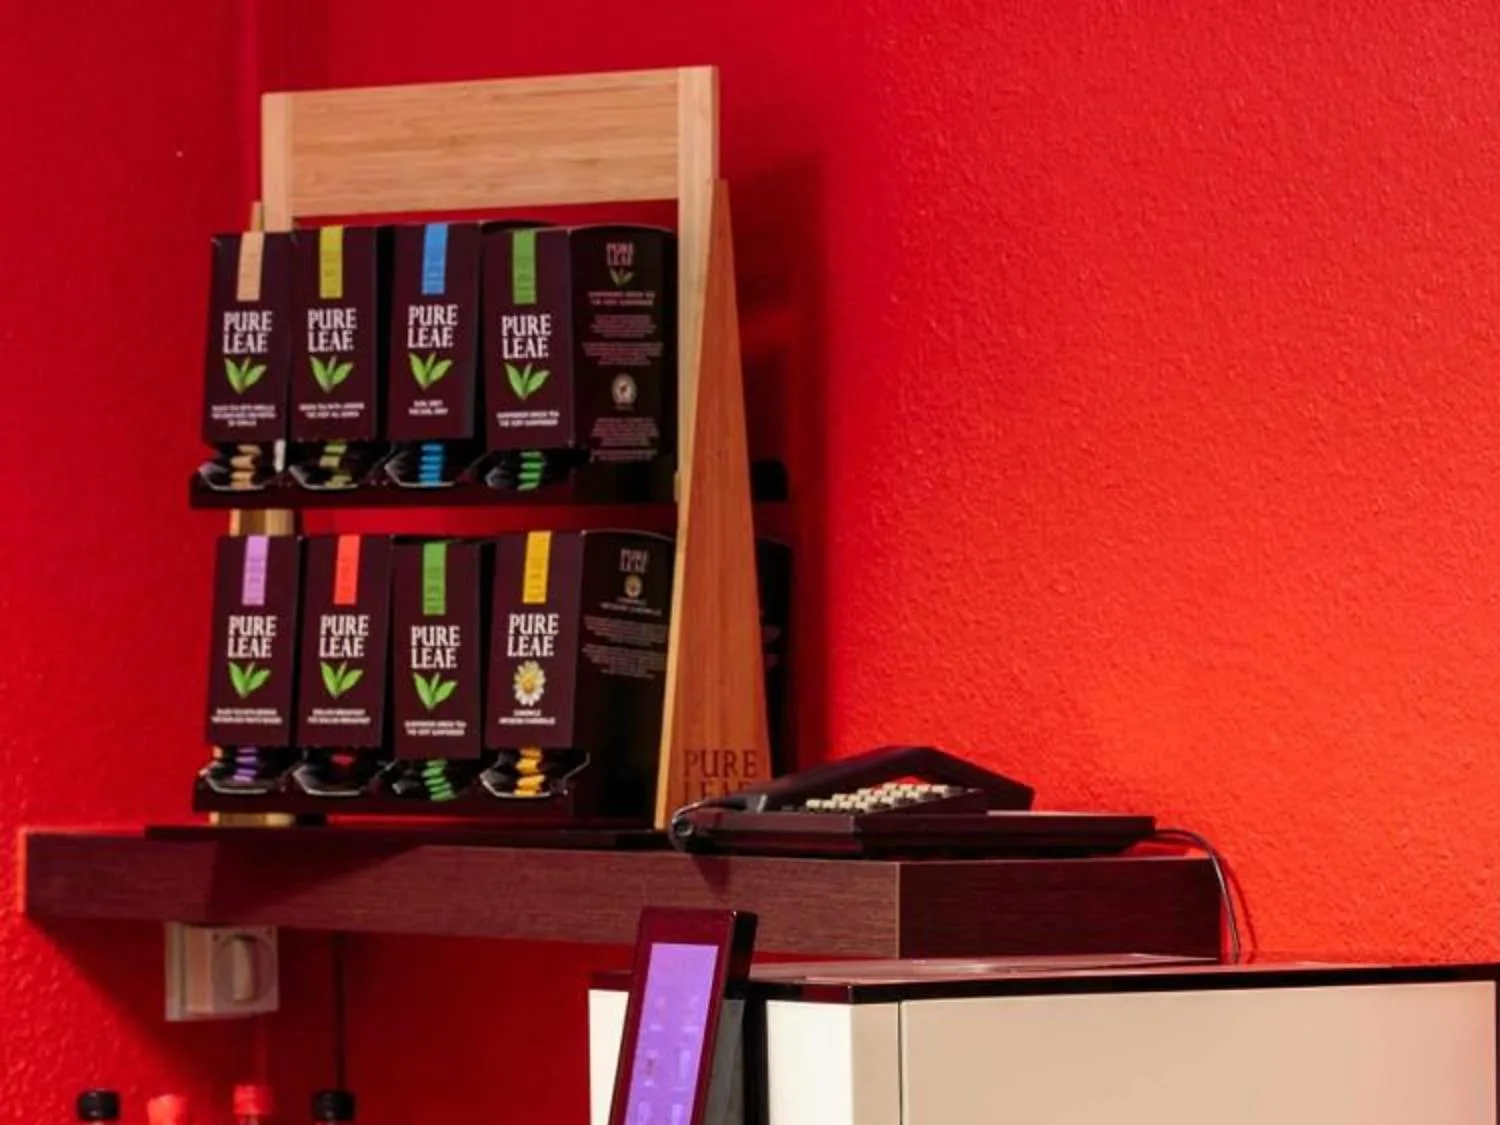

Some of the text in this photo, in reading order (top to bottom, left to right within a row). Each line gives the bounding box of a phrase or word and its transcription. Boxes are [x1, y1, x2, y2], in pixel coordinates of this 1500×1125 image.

[223, 311, 273, 332] PURE
[307, 308, 357, 329] PURE
[408, 305, 458, 326] PURE
[502, 314, 552, 336] PURE
[228, 615, 277, 636] PURE
[320, 615, 369, 636] PURE
[508, 614, 559, 635] PURE
[411, 626, 460, 646] PURE
[683, 749, 757, 778] PURE
